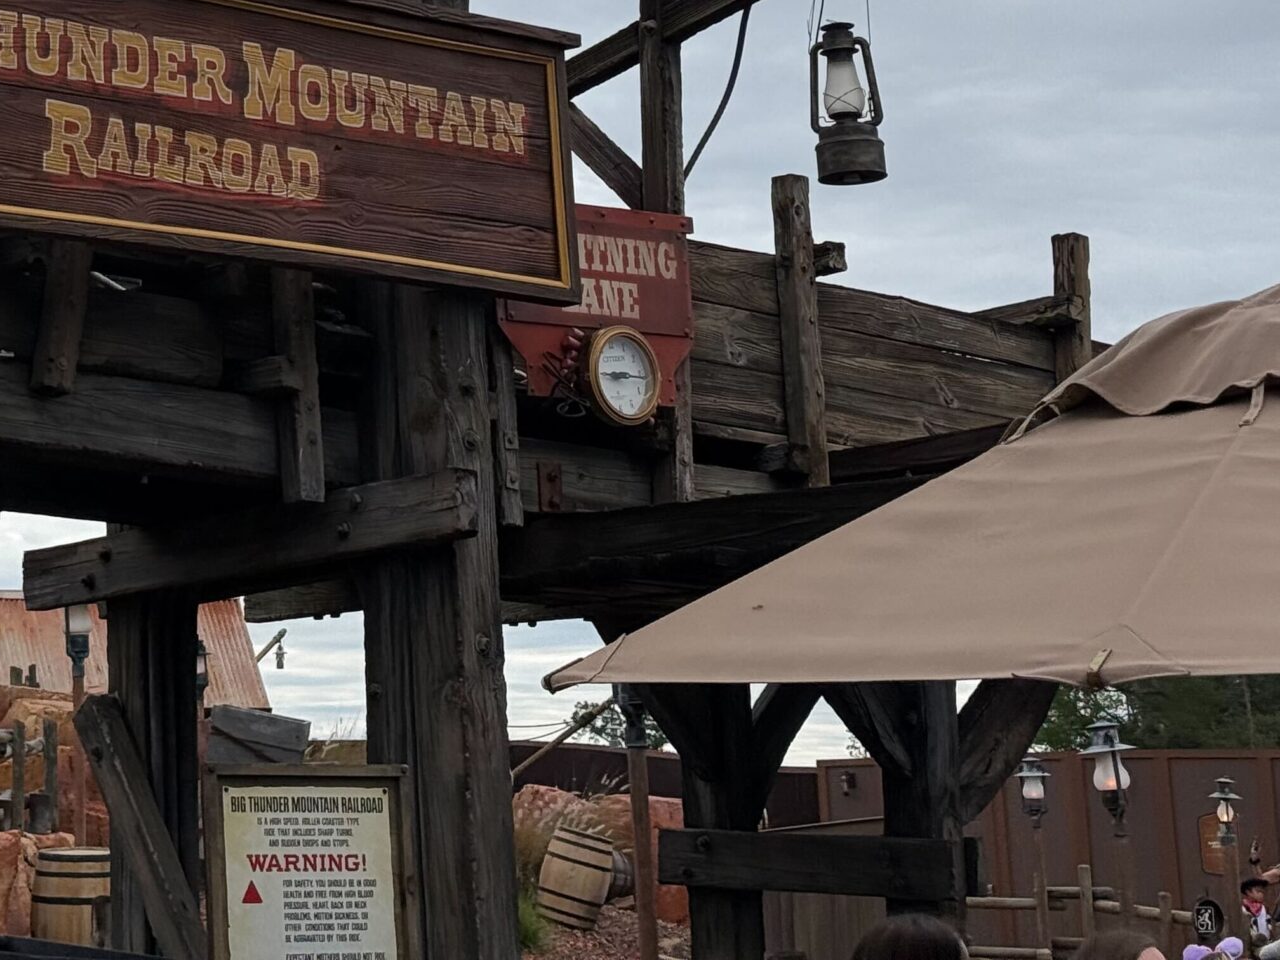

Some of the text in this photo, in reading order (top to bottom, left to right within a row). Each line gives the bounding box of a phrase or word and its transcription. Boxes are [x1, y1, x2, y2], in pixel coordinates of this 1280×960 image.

[243, 41, 526, 155] MOUNTAIN
[43, 98, 321, 200] RAILROAD
[577, 233, 678, 280] TNING
[230, 796, 383, 814] BIG THUNDER MOUNTAIN RAILROAD
[246, 854, 367, 872] WARNING!
